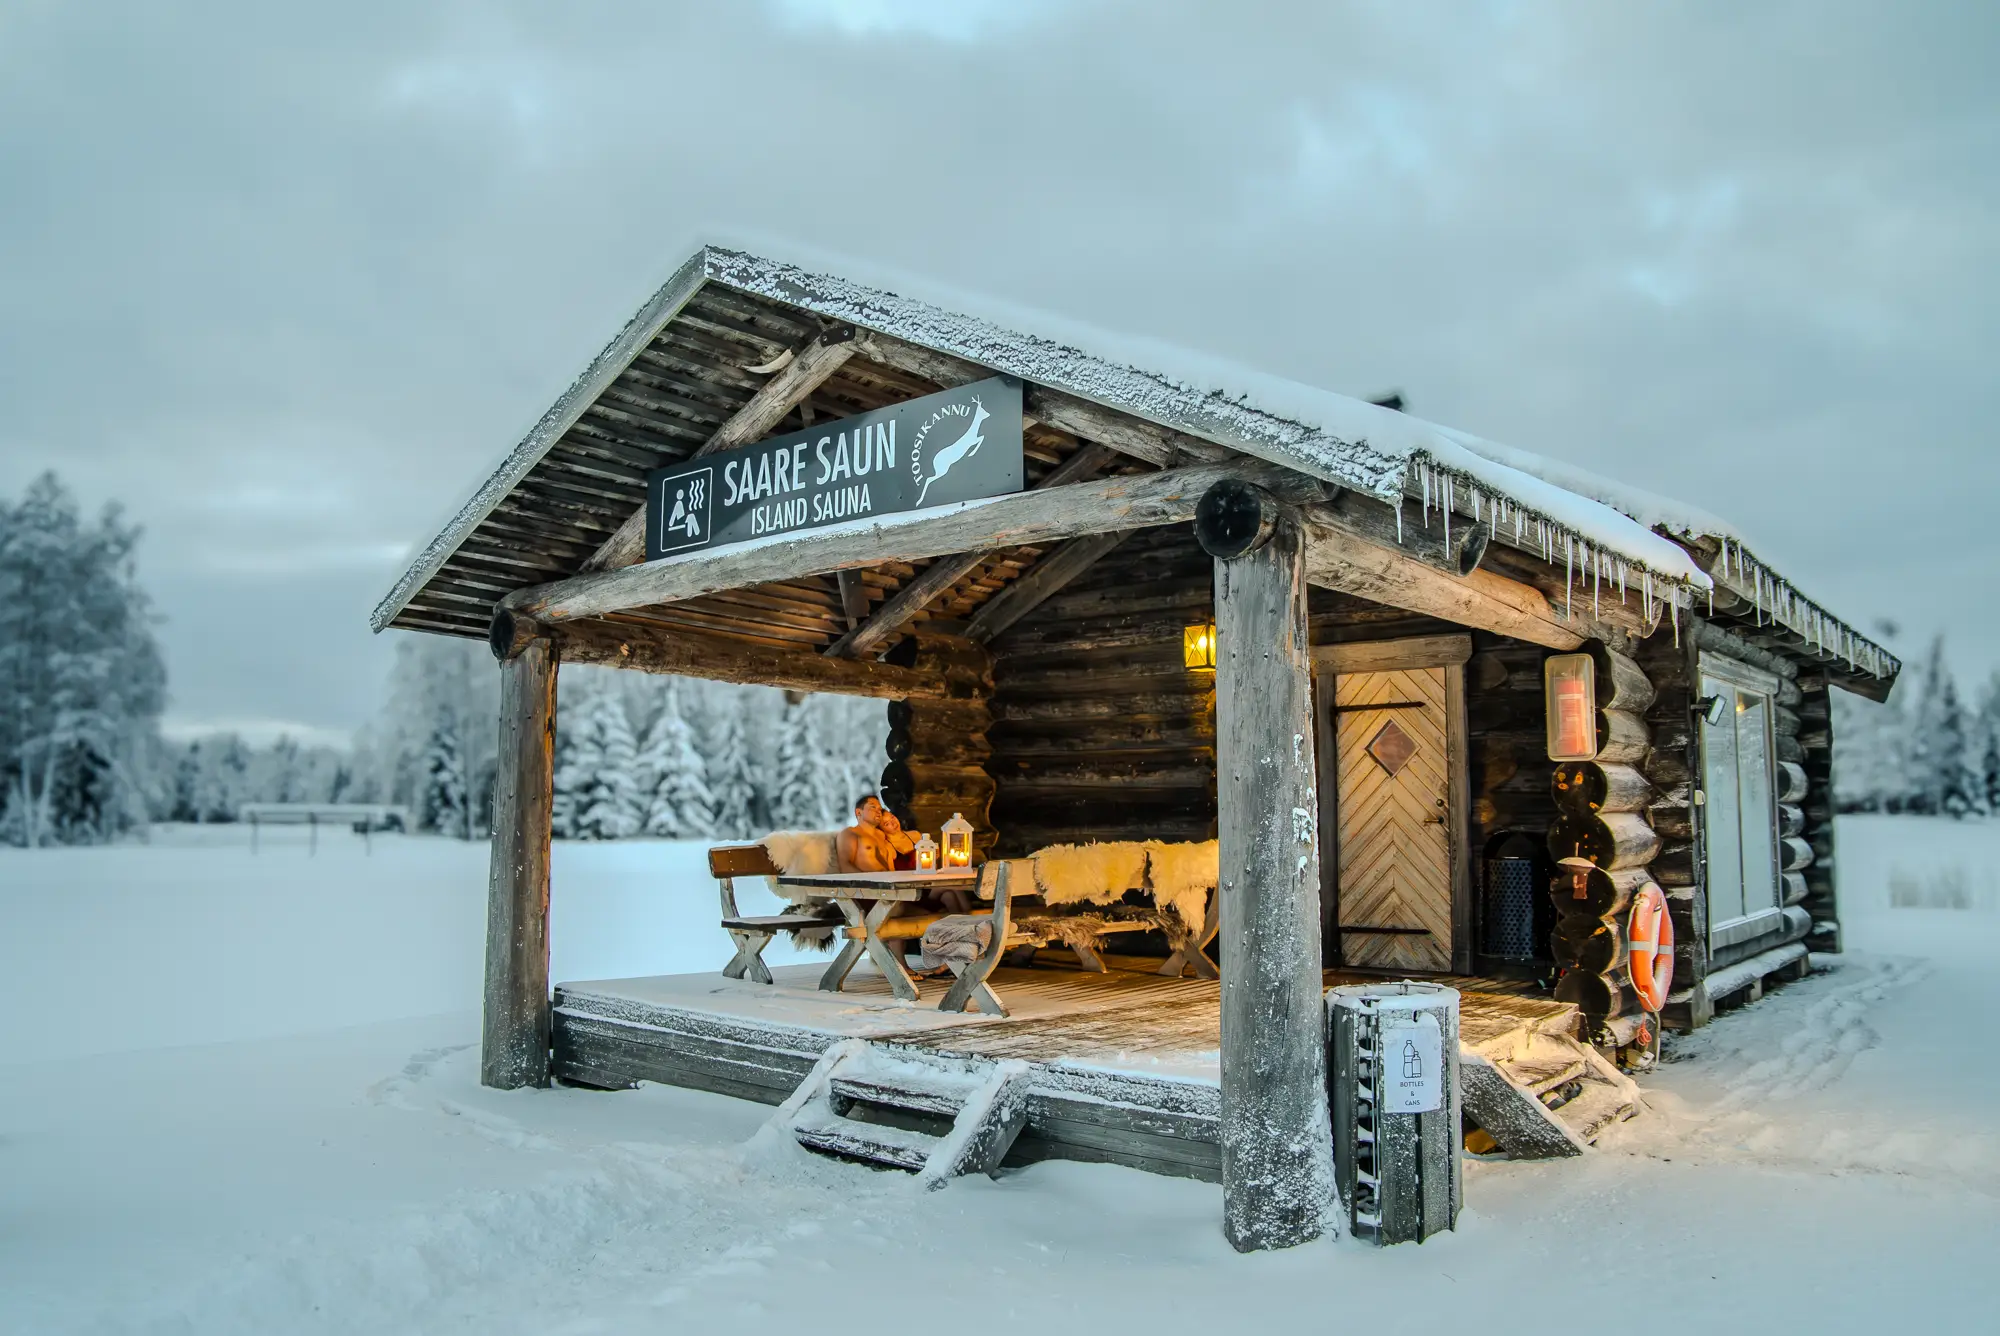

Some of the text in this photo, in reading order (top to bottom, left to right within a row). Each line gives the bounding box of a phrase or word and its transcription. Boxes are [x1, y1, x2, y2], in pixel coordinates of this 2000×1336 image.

[724, 419, 896, 507] SAARE SAUN
[911, 403, 971, 487] TOOSIKANNU
[751, 483, 872, 535] ISLAND SAUNA
